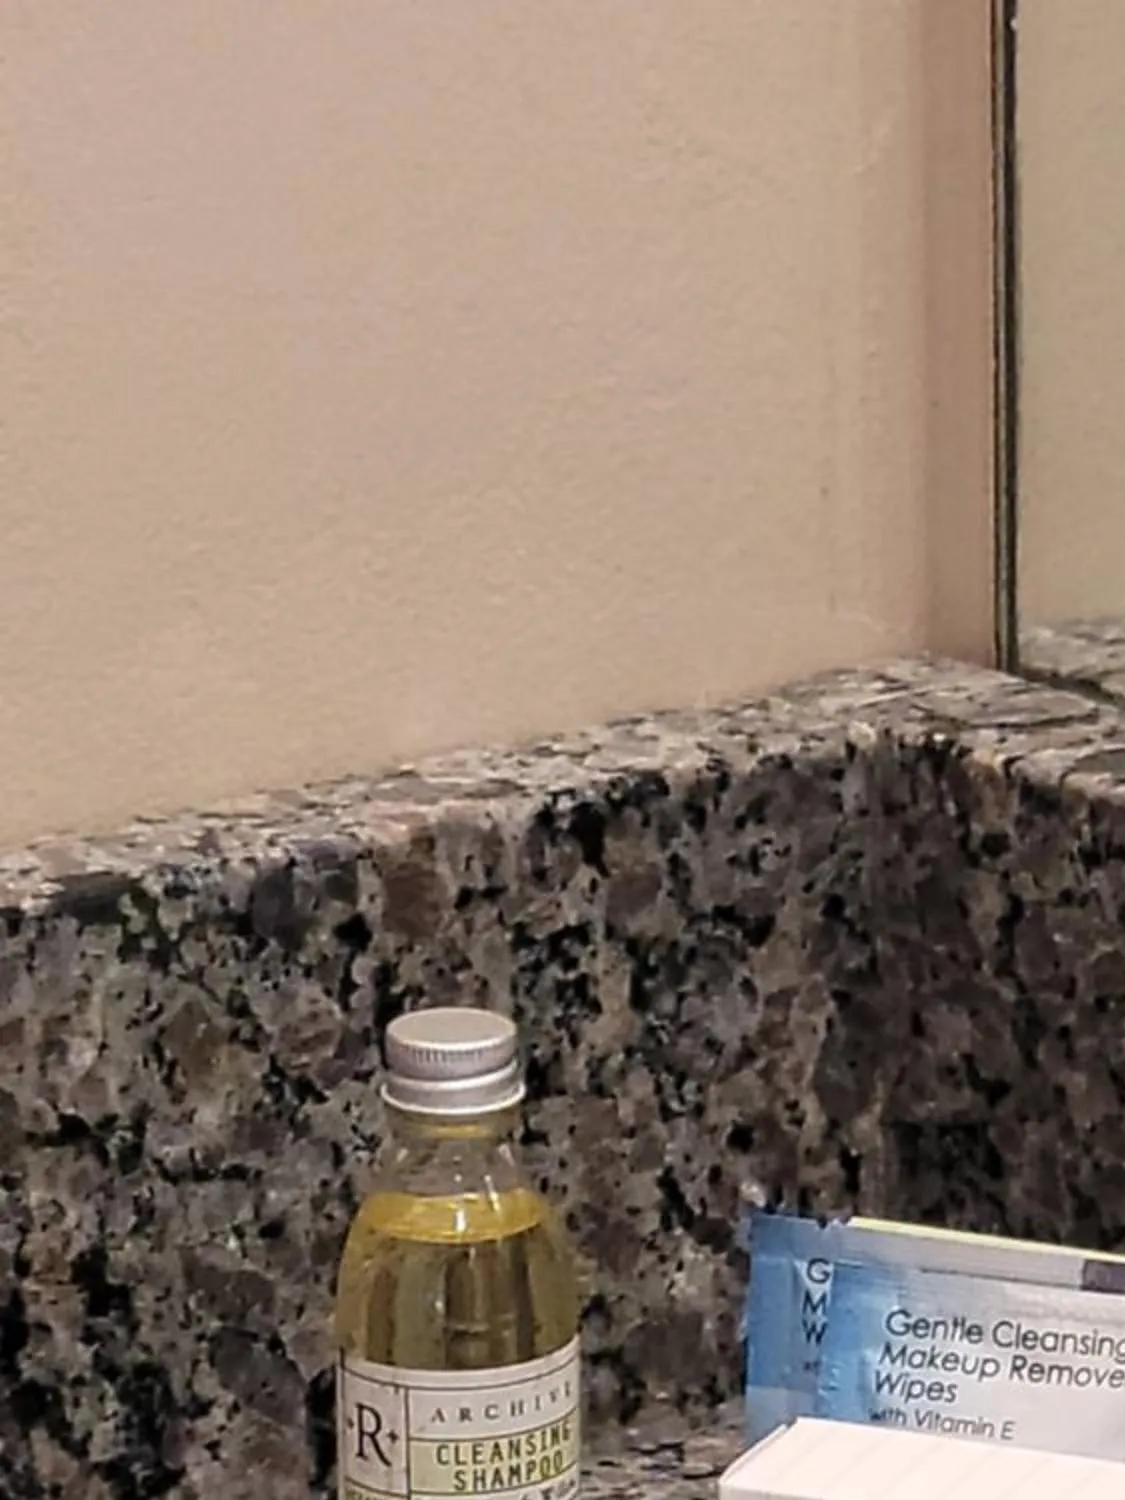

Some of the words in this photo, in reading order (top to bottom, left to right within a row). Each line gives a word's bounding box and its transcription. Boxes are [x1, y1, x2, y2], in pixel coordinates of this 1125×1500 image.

[885, 1309, 983, 1345] Gentle
[878, 1341, 1001, 1382] Makeup
[872, 1370, 958, 1404] Wipes
[354, 1401, 392, 1468] R
[868, 1405, 907, 1427] with
[914, 1409, 996, 1440] Vitamin
[1000, 1421, 1017, 1441] E
[453, 1449, 564, 1492] SHAMPOO
